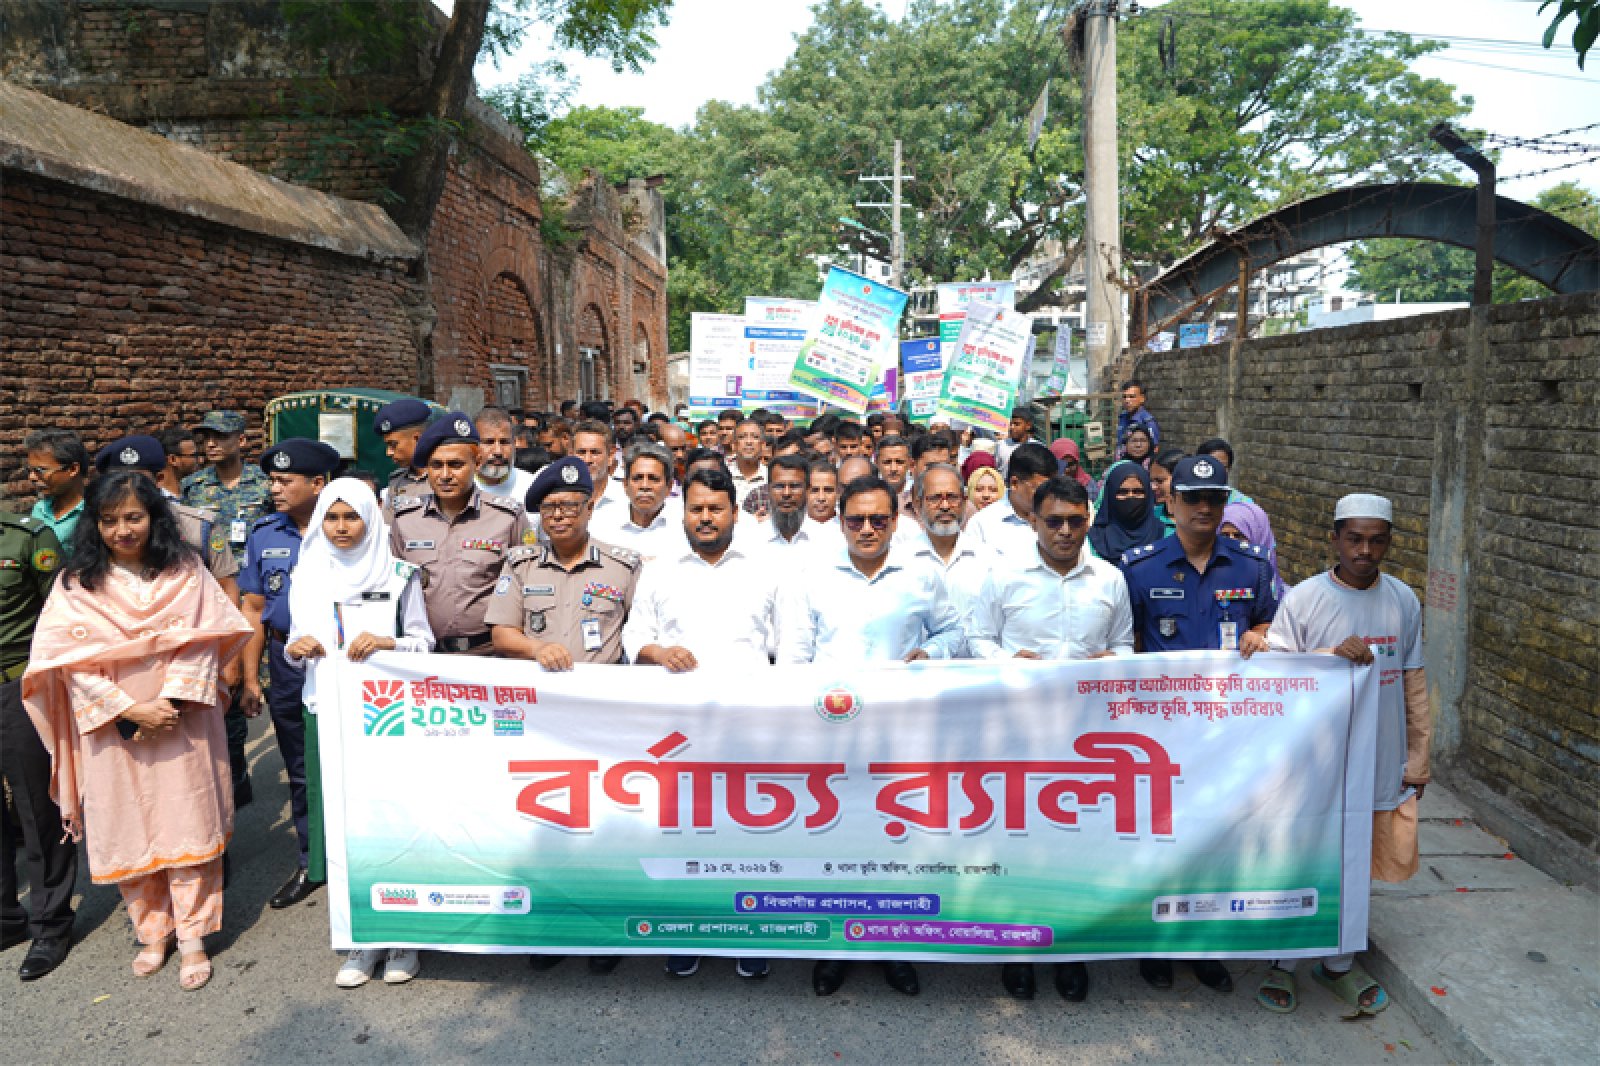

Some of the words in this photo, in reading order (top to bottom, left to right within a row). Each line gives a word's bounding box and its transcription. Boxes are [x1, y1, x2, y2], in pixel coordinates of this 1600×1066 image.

[410, 676, 489, 706] ভূমিসেবা
[493, 685, 538, 706] মেলা
[1076, 679, 1137, 695] জনবান্ধব
[1214, 674, 1243, 698] ভূমি
[411, 706, 487, 727] ২০২৬
[1107, 696, 1159, 721] সুরক্ষিত
[1161, 696, 1191, 722] ভূমি,
[1192, 700, 1229, 722] সমৃদ্ধ
[507, 731, 846, 830] বর্ণাঢ্য
[867, 731, 1182, 838] র‍্যালী
[877, 895, 932, 910] রাজশাহী
[759, 921, 820, 936] রাজশাহী
